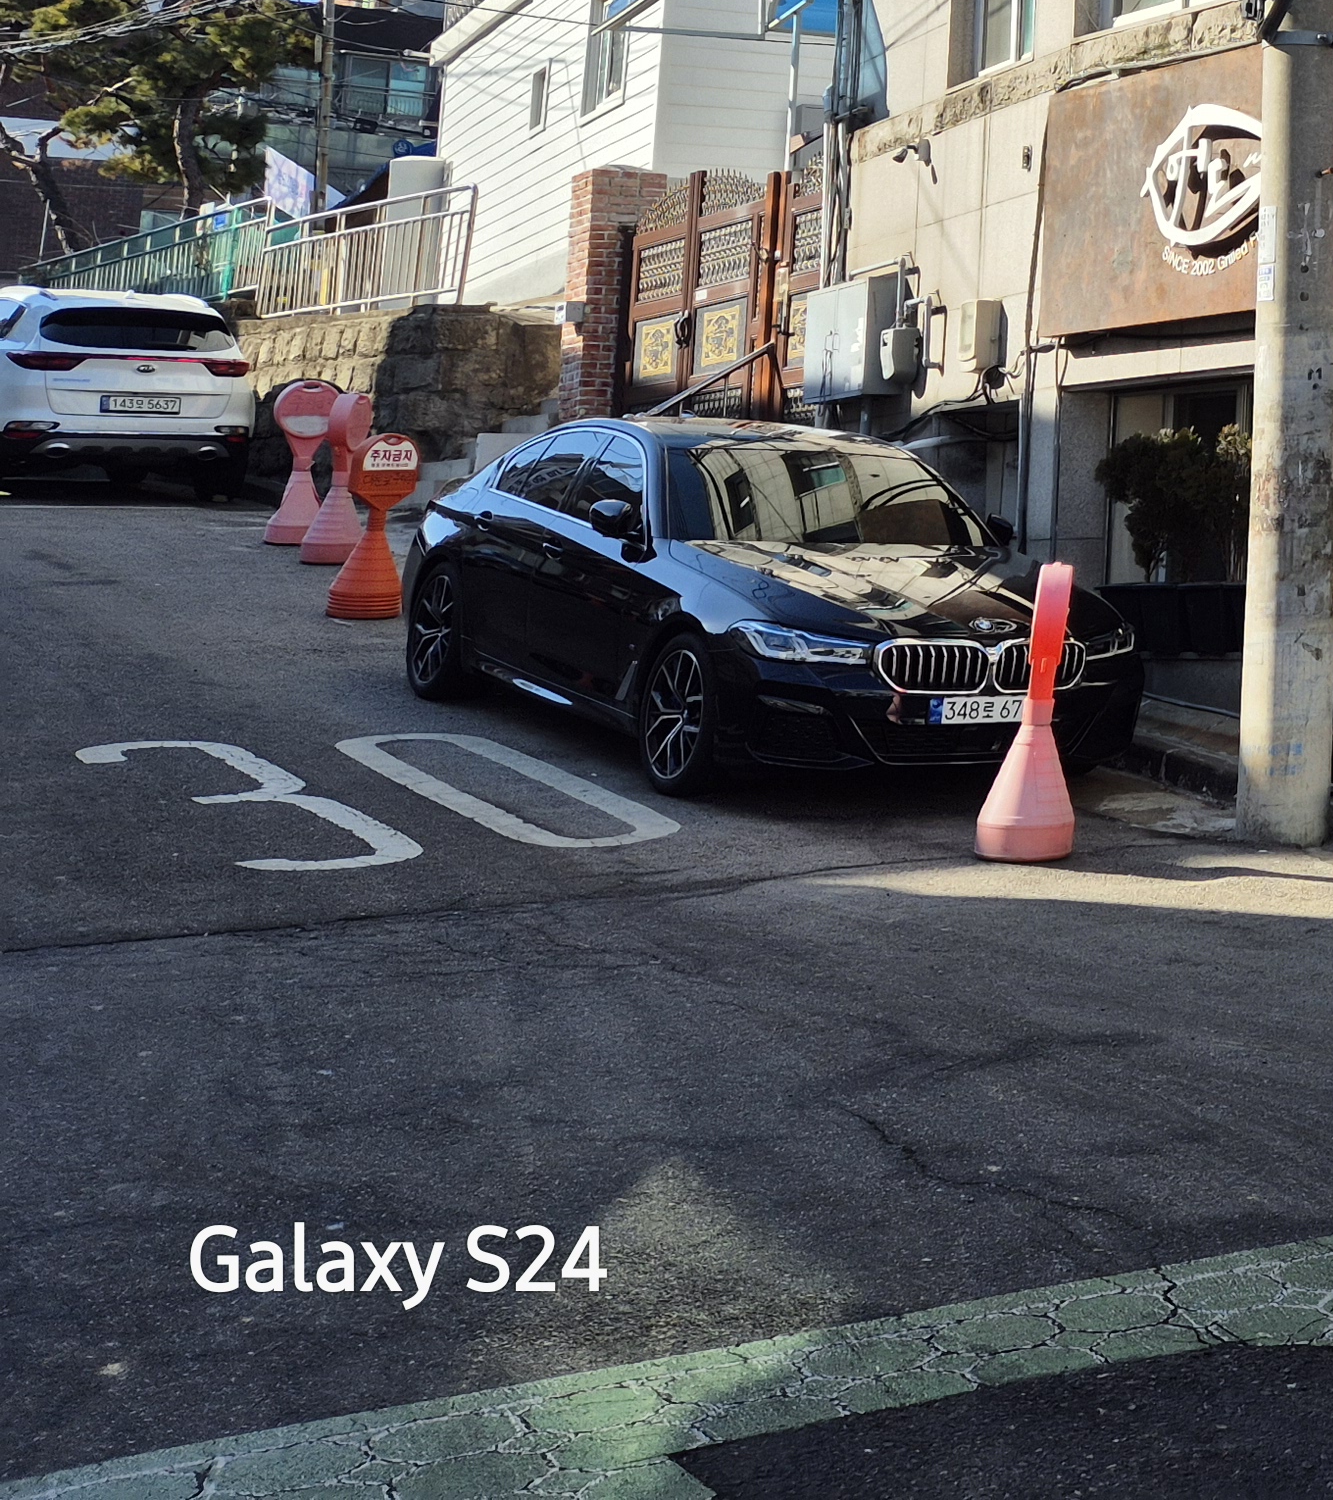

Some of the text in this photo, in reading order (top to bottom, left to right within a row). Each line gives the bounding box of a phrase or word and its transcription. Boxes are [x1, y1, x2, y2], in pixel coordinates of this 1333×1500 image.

[1161, 244, 1190, 275] SINCE
[1190, 258, 1216, 277] 2002
[147, 399, 177, 411] 5637
[945, 700, 995, 720] 348로
[75, 732, 682, 871] 30
